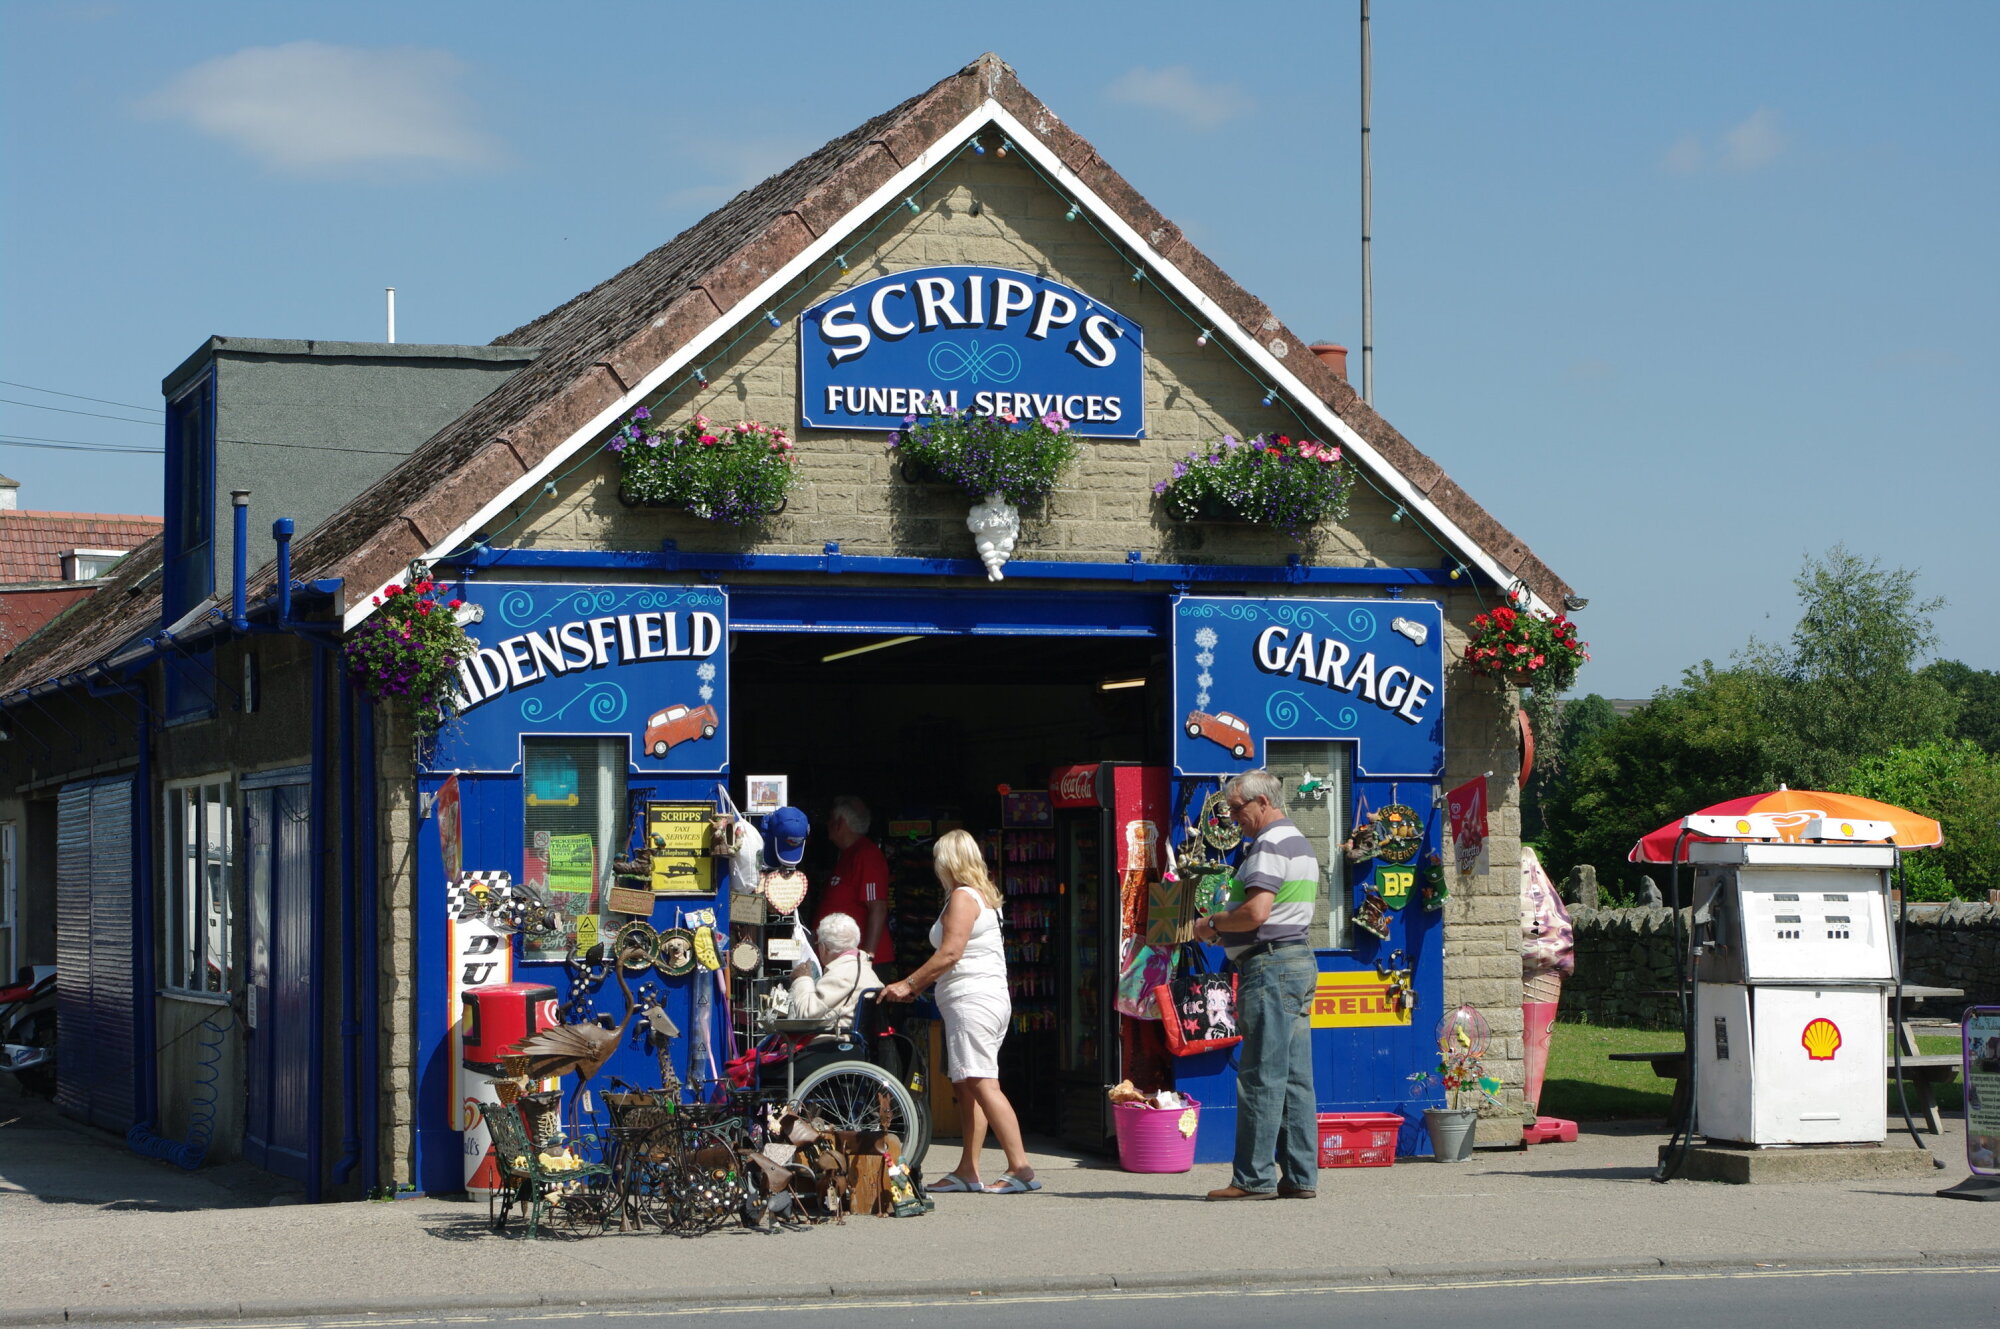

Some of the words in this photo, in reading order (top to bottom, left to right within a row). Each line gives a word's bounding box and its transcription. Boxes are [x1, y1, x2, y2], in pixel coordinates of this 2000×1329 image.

[821, 275, 1125, 368] SCRIPP'S
[826, 385, 966, 417] FUNERAL
[973, 391, 1122, 422] SERVICES
[439, 611, 722, 722] IDENSFIELD
[1257, 625, 1434, 724] GARAGE
[660, 811, 702, 821] SCRIPPS'
[1378, 806, 1418, 821] WELCOME
[665, 833, 701, 841] SERVICES
[661, 849, 689, 857] Telephone
[1382, 844, 1419, 860] FRIENDS
[1456, 845, 1481, 862] Cornetto
[1382, 872, 1414, 897] BP
[541, 935, 567, 950] Soft
[1308, 997, 1401, 1015] RELLI
